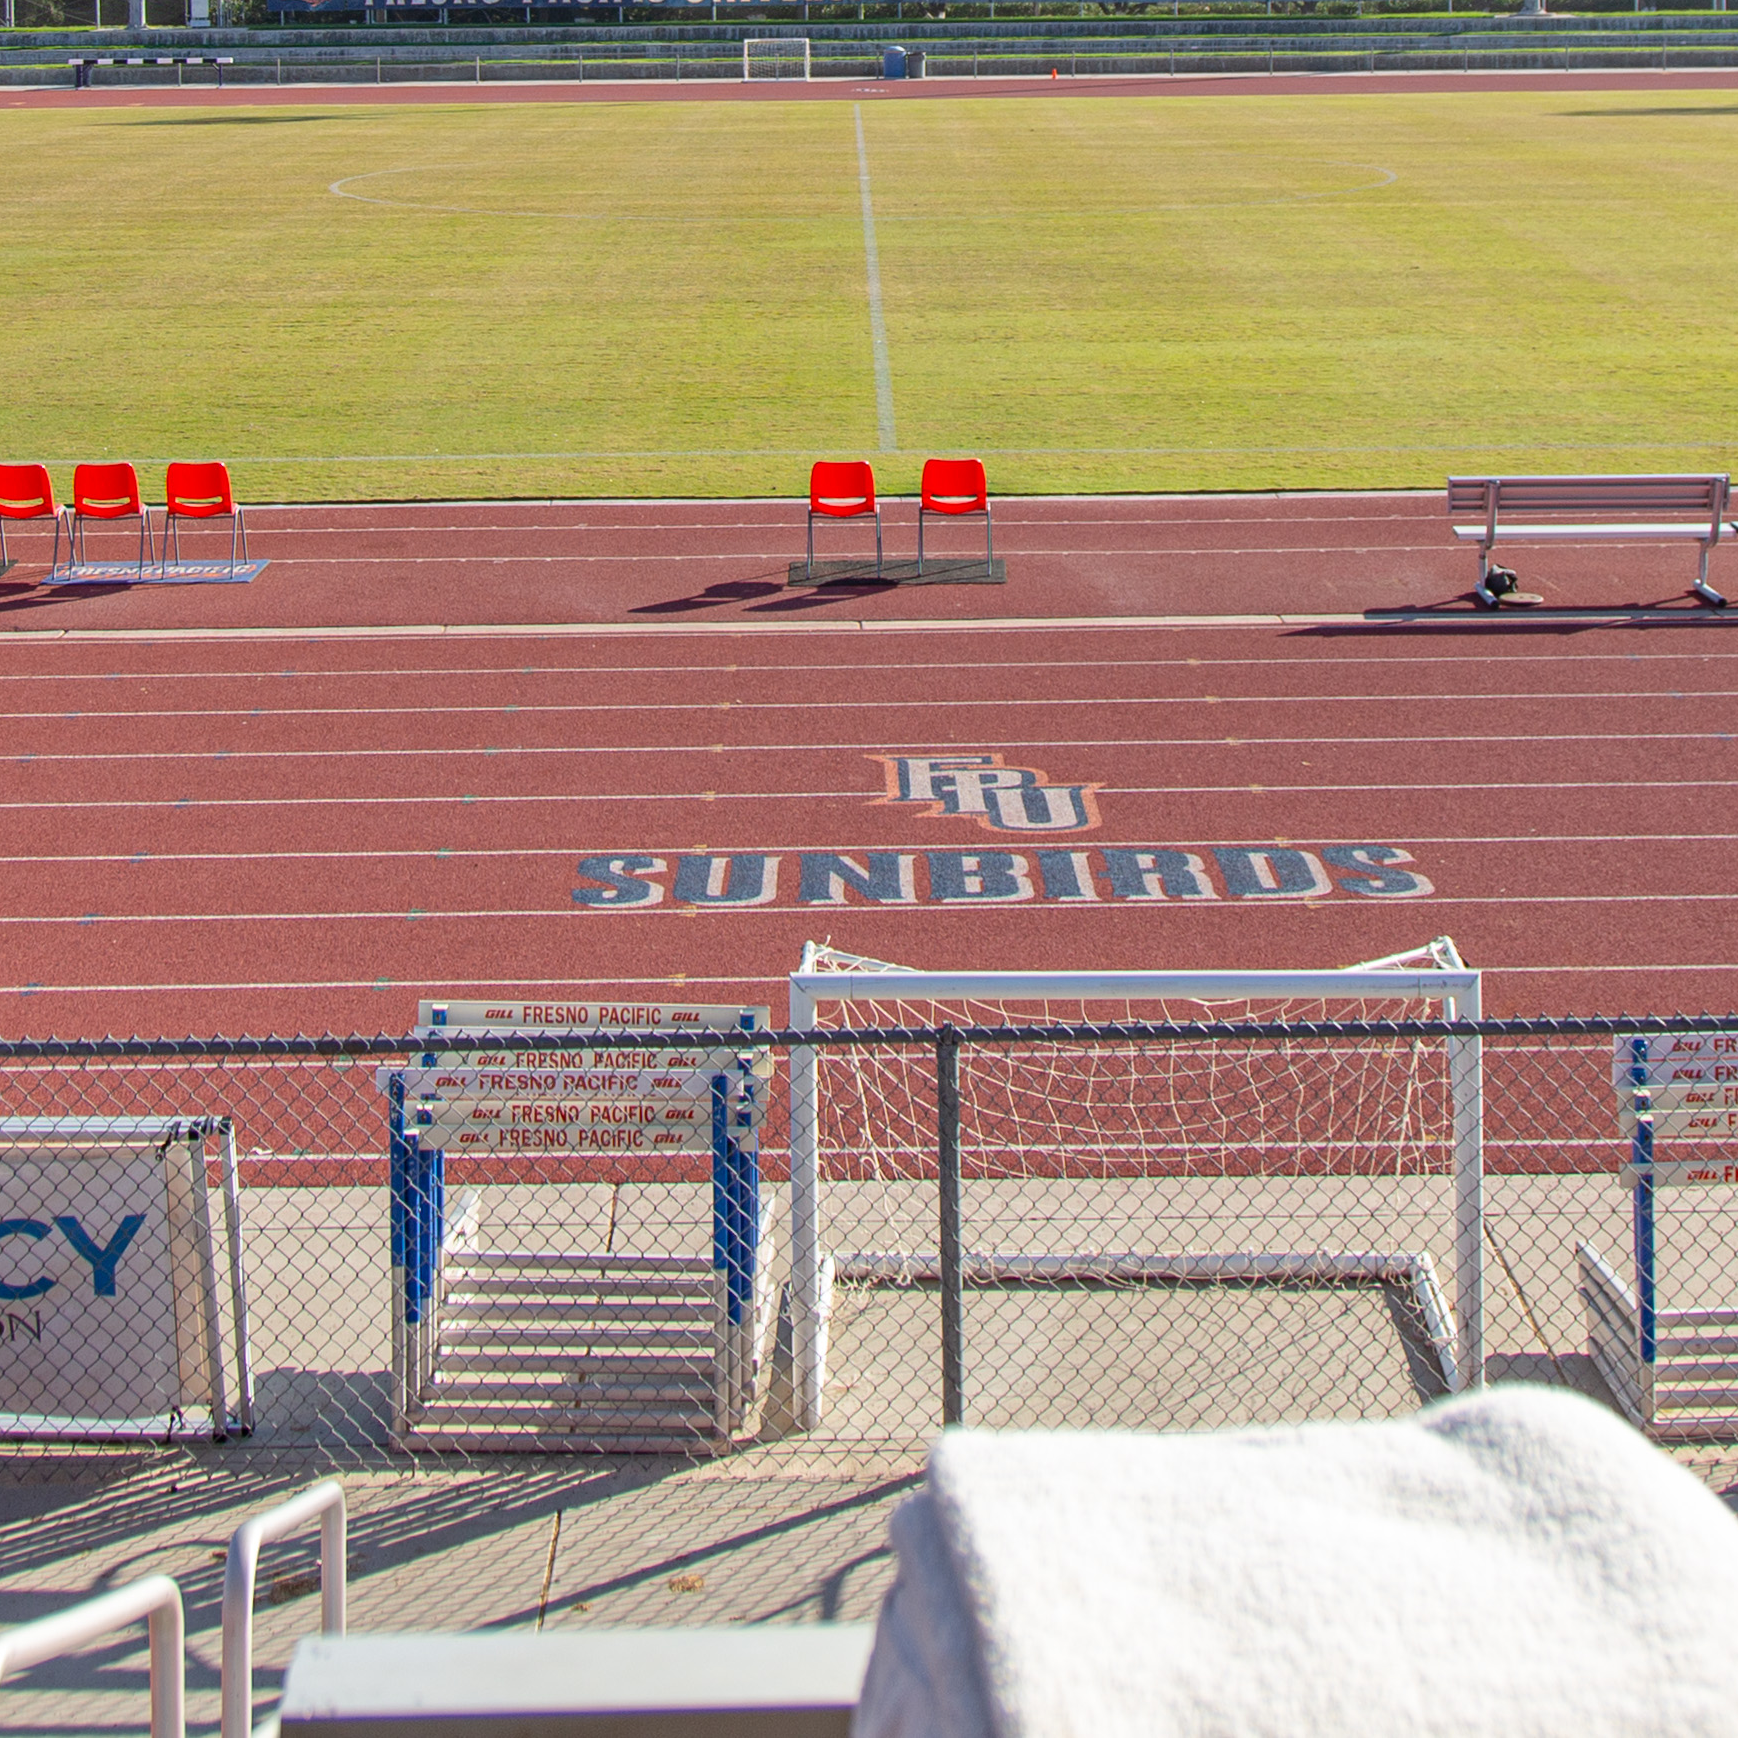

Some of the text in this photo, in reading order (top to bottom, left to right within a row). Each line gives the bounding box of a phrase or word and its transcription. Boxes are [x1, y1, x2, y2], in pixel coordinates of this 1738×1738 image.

[866, 753, 1106, 834] FPU
[570, 844, 1436, 908] SUNBIRDS
[523, 1006, 588, 1024] FRESNO
[599, 1007, 661, 1025] PACIFIC
[516, 1052, 583, 1068] FRESNO
[594, 1053, 657, 1069] PACIFIC
[479, 1074, 557, 1090] FRESNO
[563, 1075, 638, 1090] PACIFIC
[511, 1105, 580, 1123] FRESNO
[590, 1105, 655, 1123] PACIFIC
[499, 1129, 568, 1147] FRESNO
[578, 1129, 643, 1148] PACIFIC
